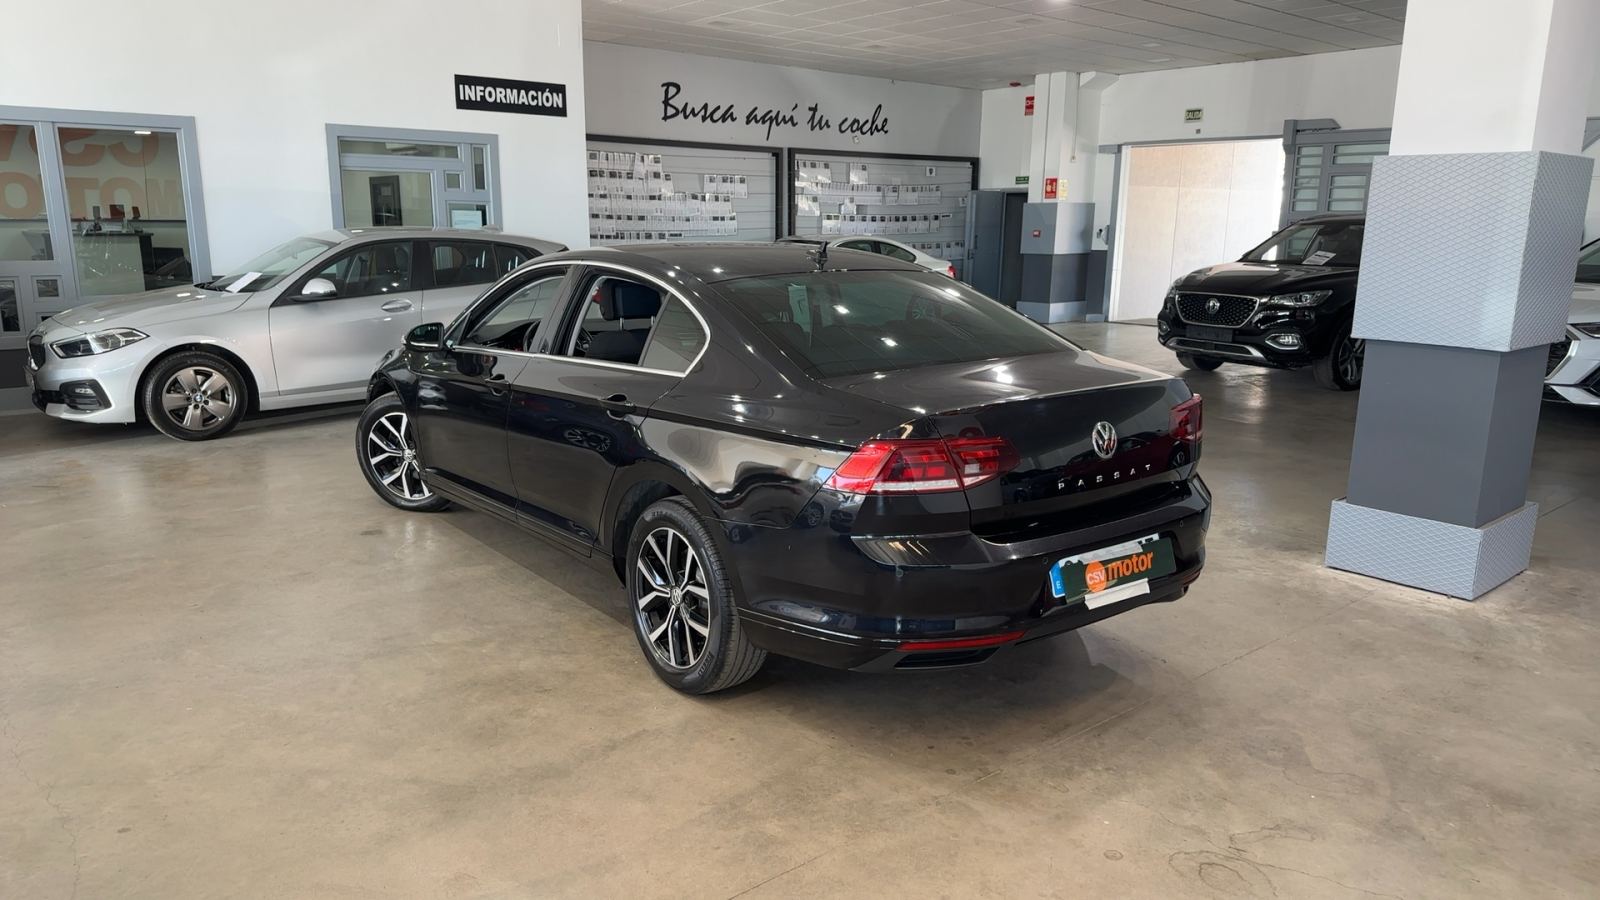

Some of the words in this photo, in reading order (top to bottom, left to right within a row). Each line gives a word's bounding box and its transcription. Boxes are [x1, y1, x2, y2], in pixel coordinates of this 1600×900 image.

[459, 84, 563, 108] INFORMACIÓN
[661, 82, 737, 123] Busca
[745, 104, 798, 141] aquí
[808, 103, 831, 131] tu
[838, 104, 889, 136] coche
[1058, 464, 1151, 490] PASSAT
[1087, 569, 1105, 584] CSV
[1107, 551, 1154, 581] motor
[1056, 580, 1062, 589] E
